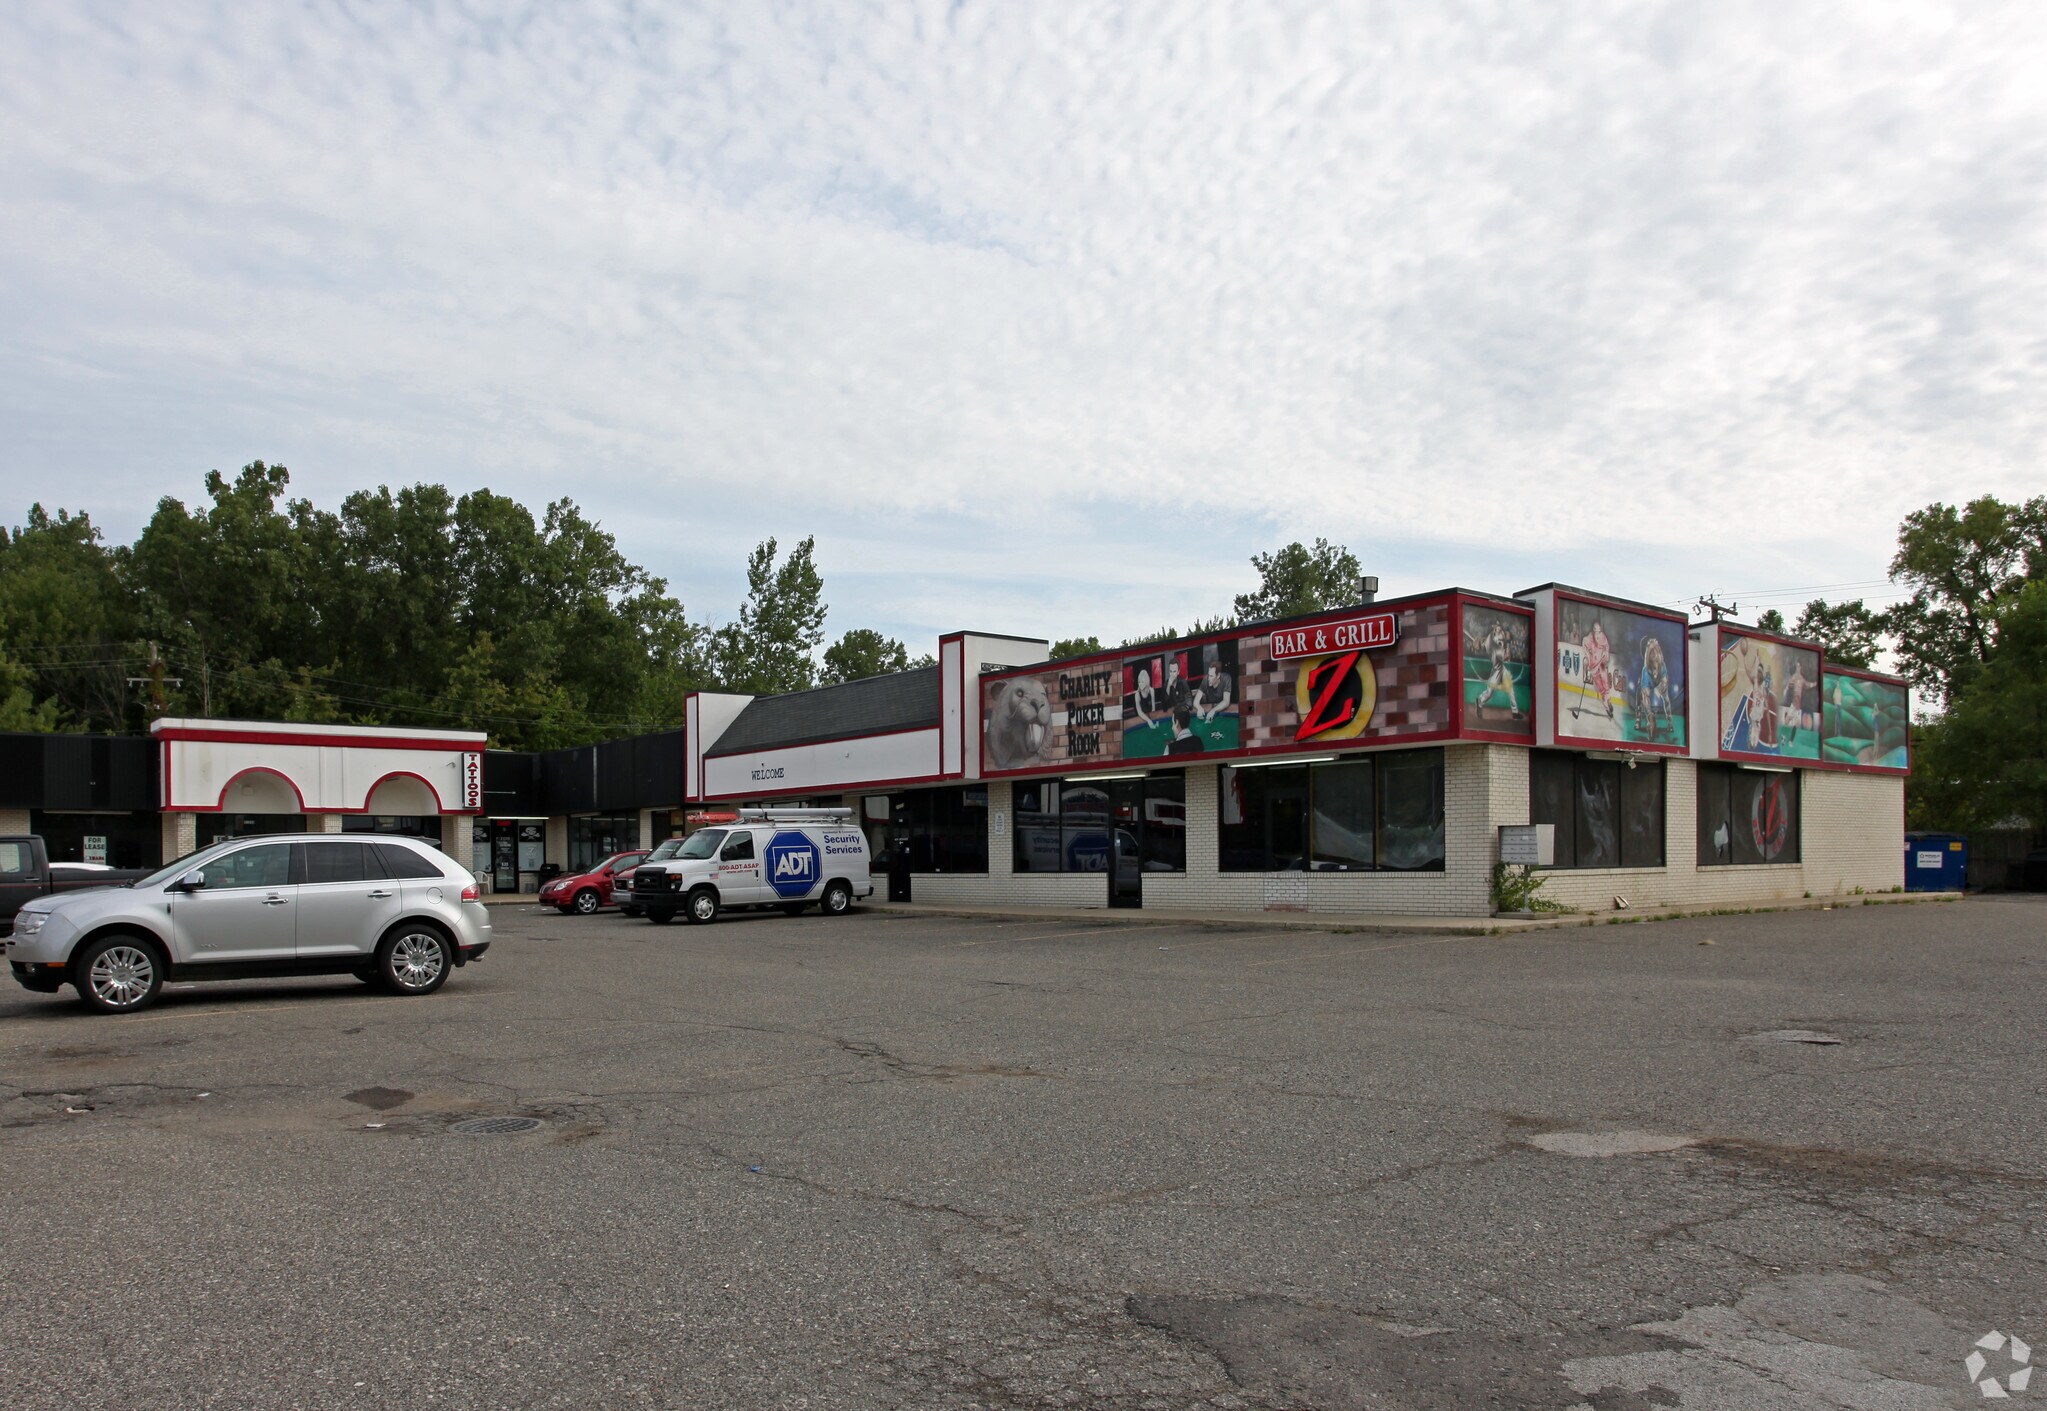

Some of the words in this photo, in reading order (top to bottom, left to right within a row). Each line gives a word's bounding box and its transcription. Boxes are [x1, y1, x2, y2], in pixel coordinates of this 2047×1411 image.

[1275, 632, 1308, 655] BAR
[1315, 629, 1327, 650] &
[1334, 620, 1390, 647] GRILL
[1060, 671, 1112, 700] CHARITY
[1294, 650, 1359, 741] Z
[1066, 702, 1105, 728] POKER
[1068, 730, 1100, 757] ROOM
[467, 754, 479, 806] TATTOOS
[751, 767, 785, 780] WELCOME
[824, 835, 860, 844] Security
[826, 846, 862, 854] Services
[776, 852, 812, 875] ADT
